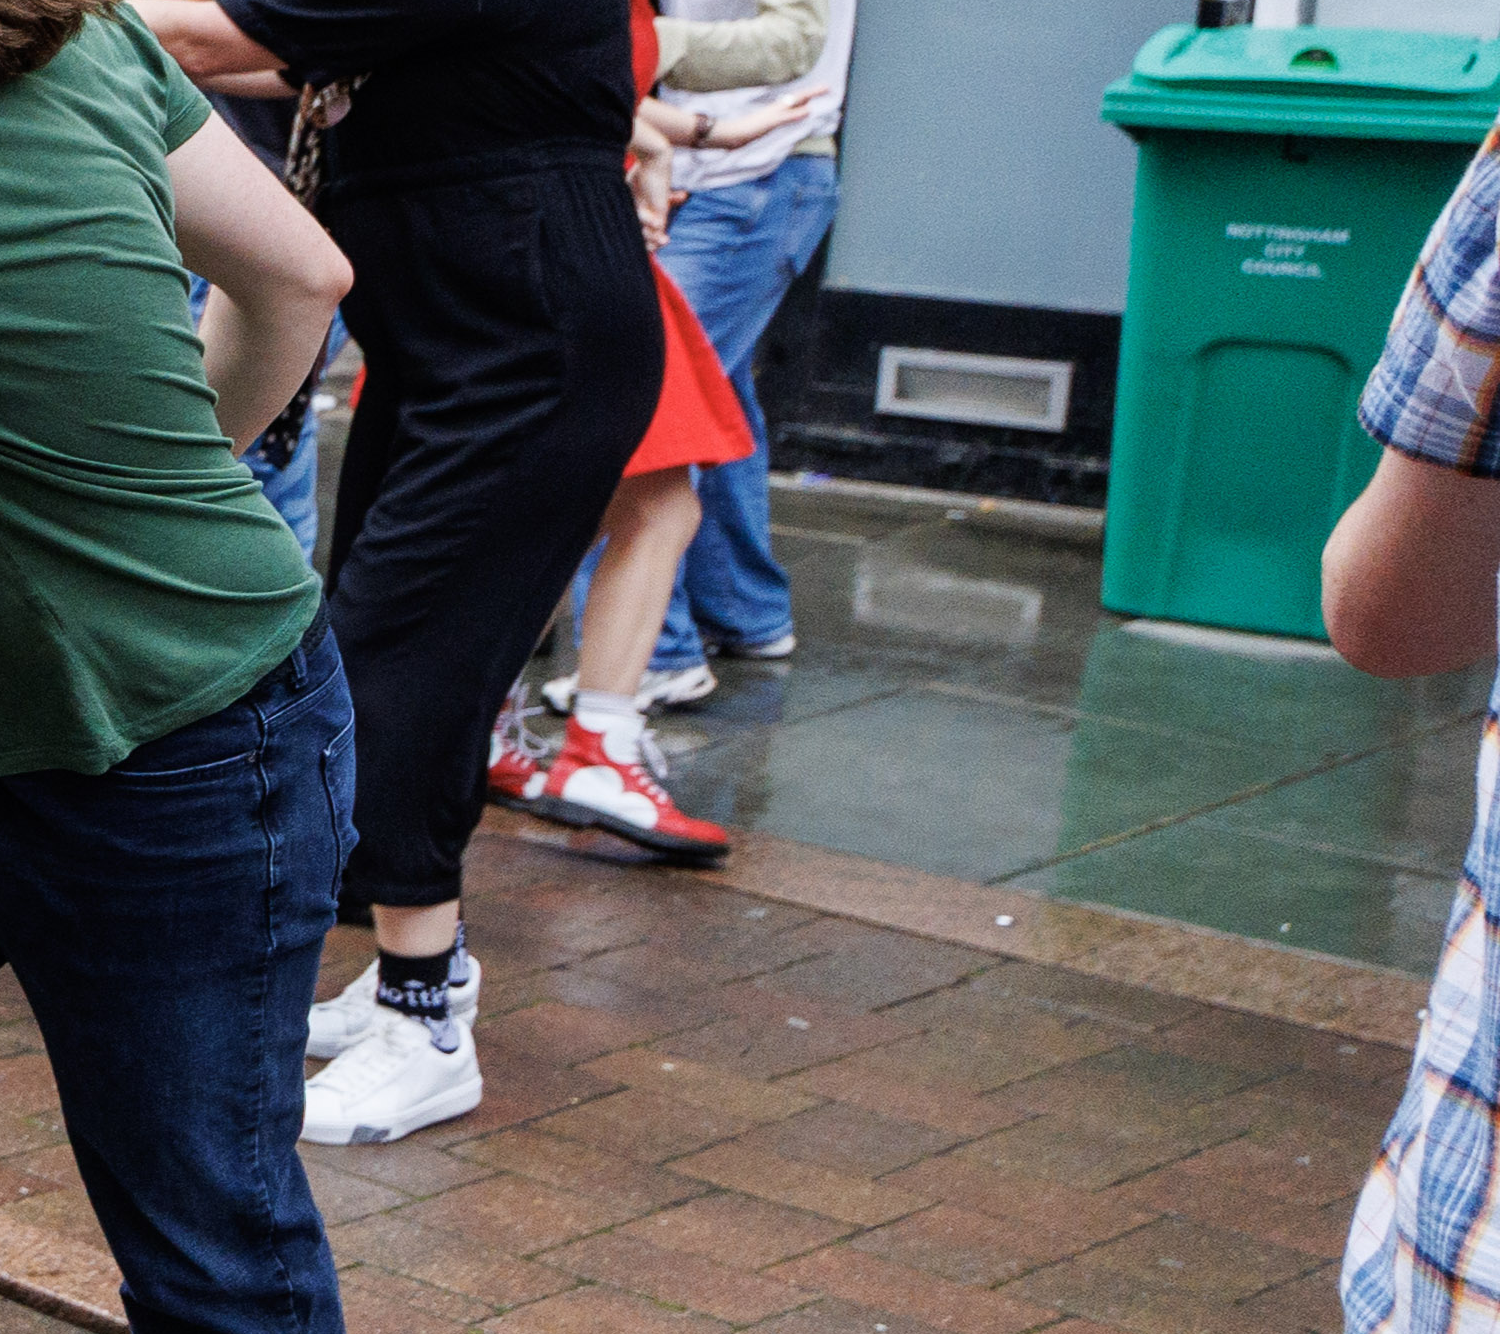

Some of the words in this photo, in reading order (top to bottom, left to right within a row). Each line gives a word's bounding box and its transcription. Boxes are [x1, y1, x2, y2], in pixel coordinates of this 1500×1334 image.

[1225, 223, 1350, 244] NOTTINGHAM
[1264, 242, 1305, 259] CITY
[1241, 259, 1322, 279] COUNCIL
